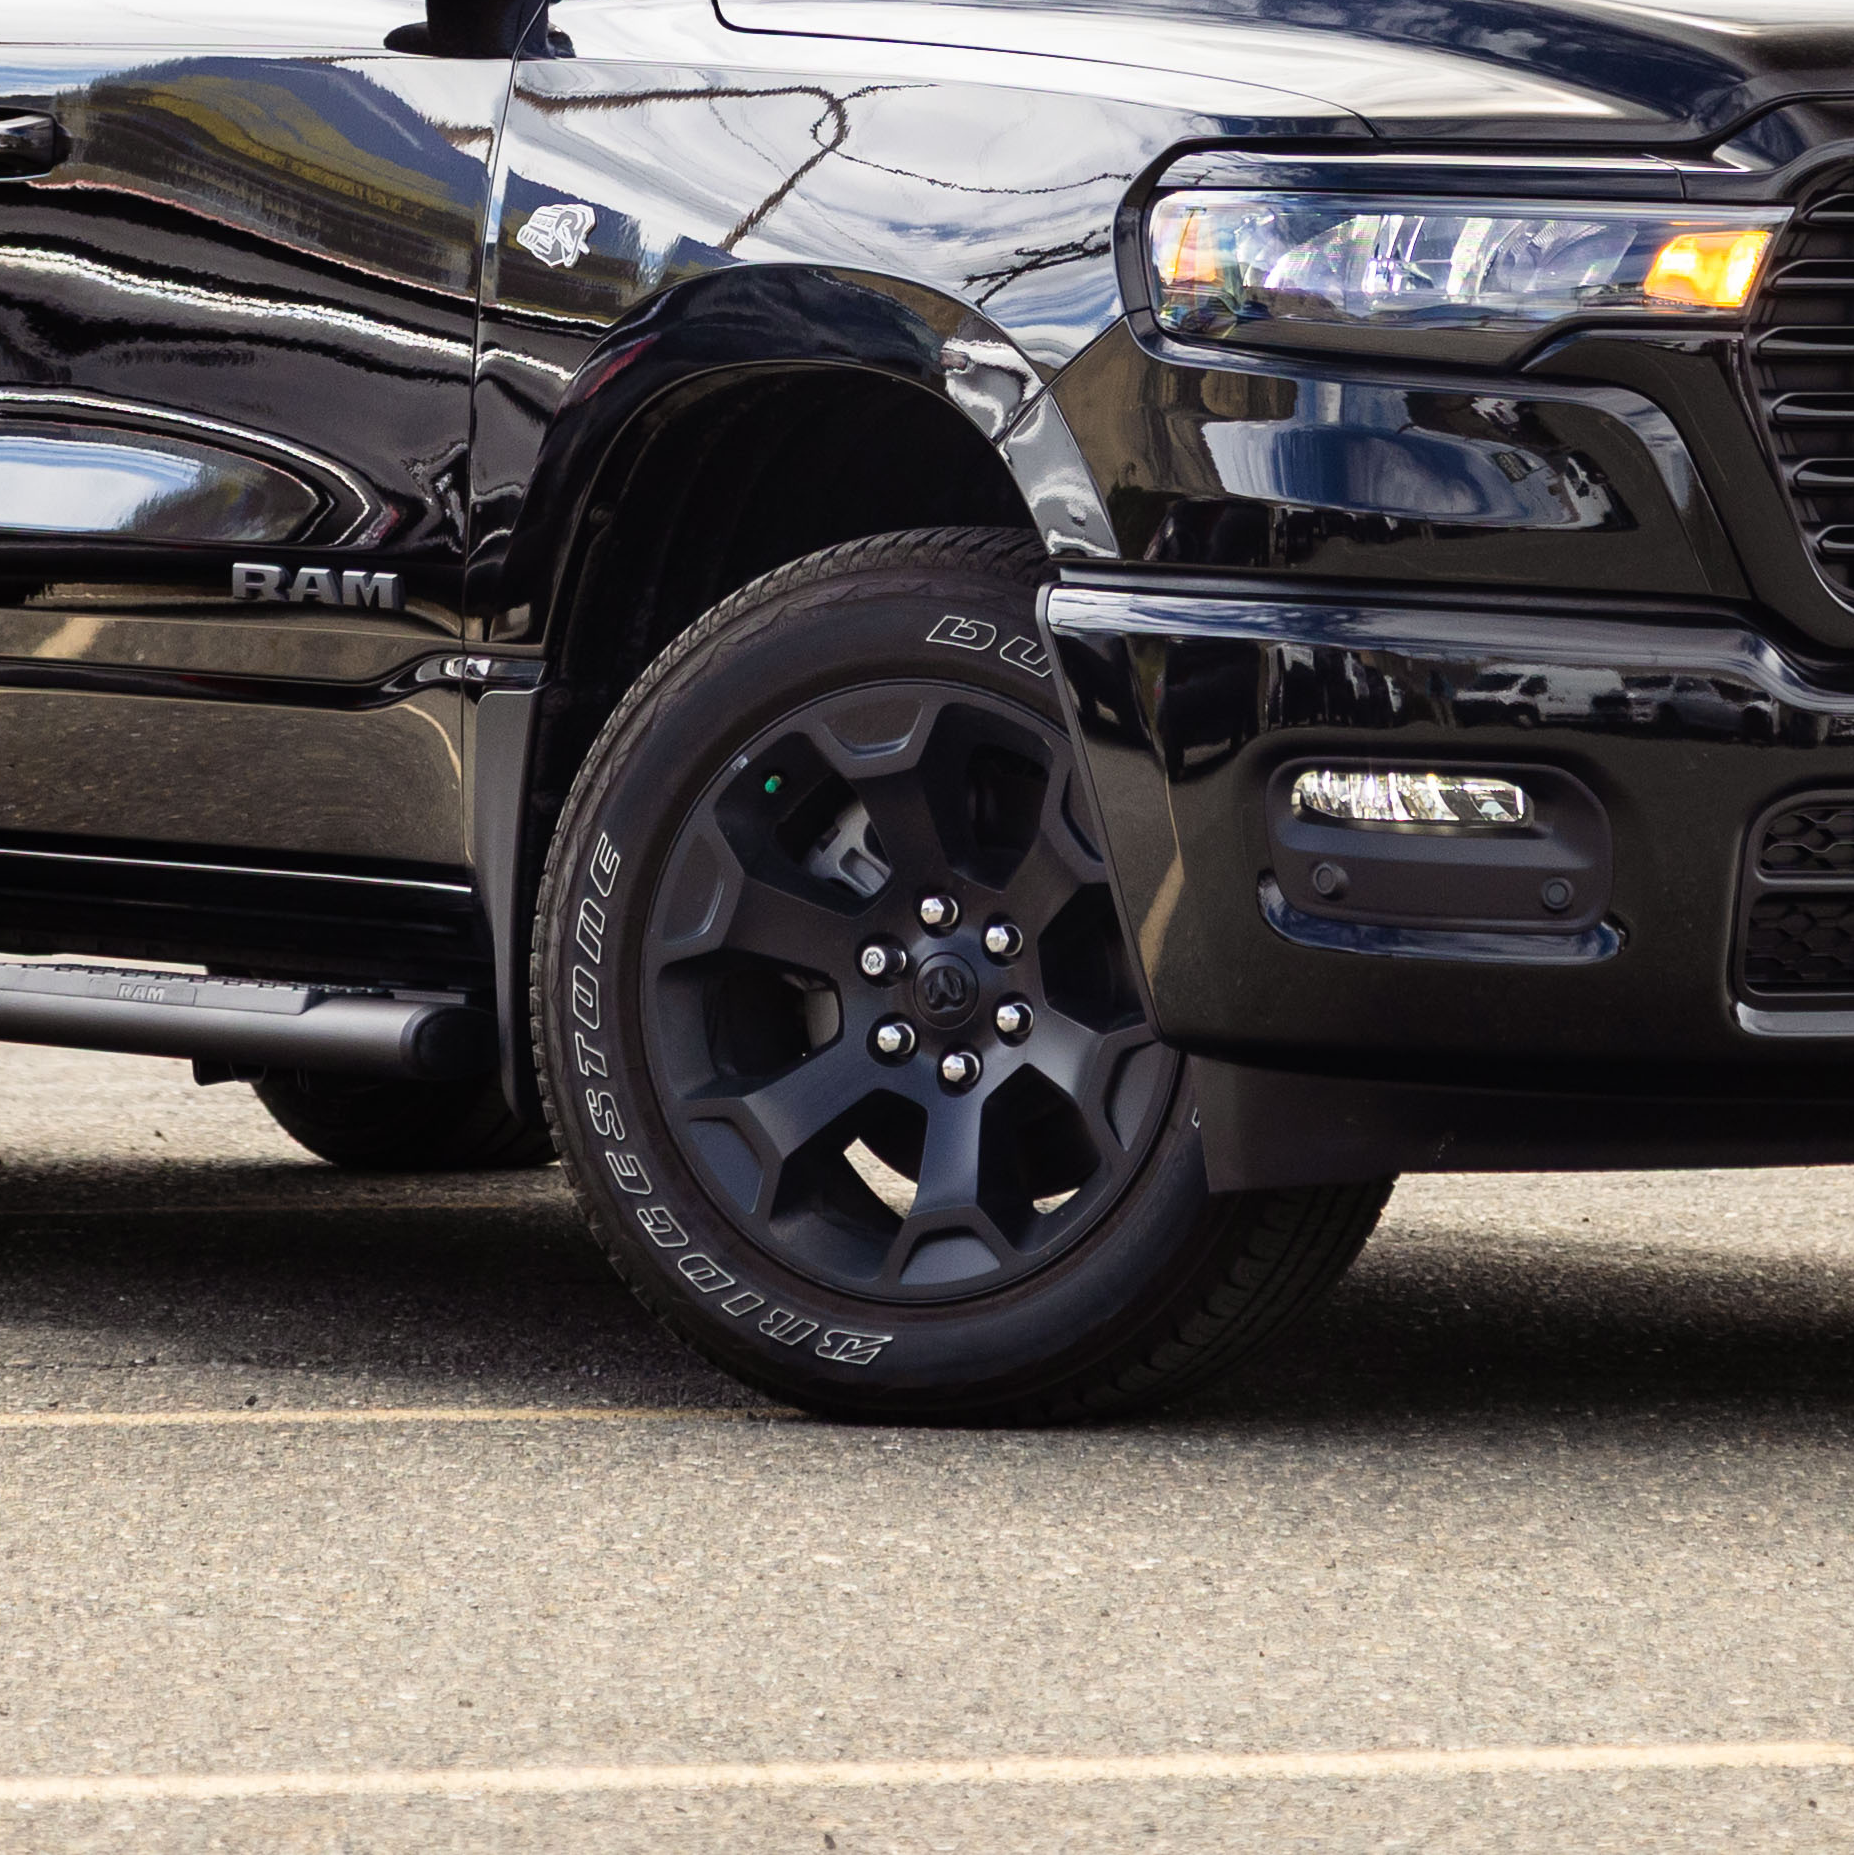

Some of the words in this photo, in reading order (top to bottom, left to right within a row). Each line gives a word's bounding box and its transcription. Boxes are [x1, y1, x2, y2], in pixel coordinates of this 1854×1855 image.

[231, 562, 404, 610] RAM
[116, 983, 166, 1002] RAM
[572, 831, 894, 1366] BRIDGESTONE
